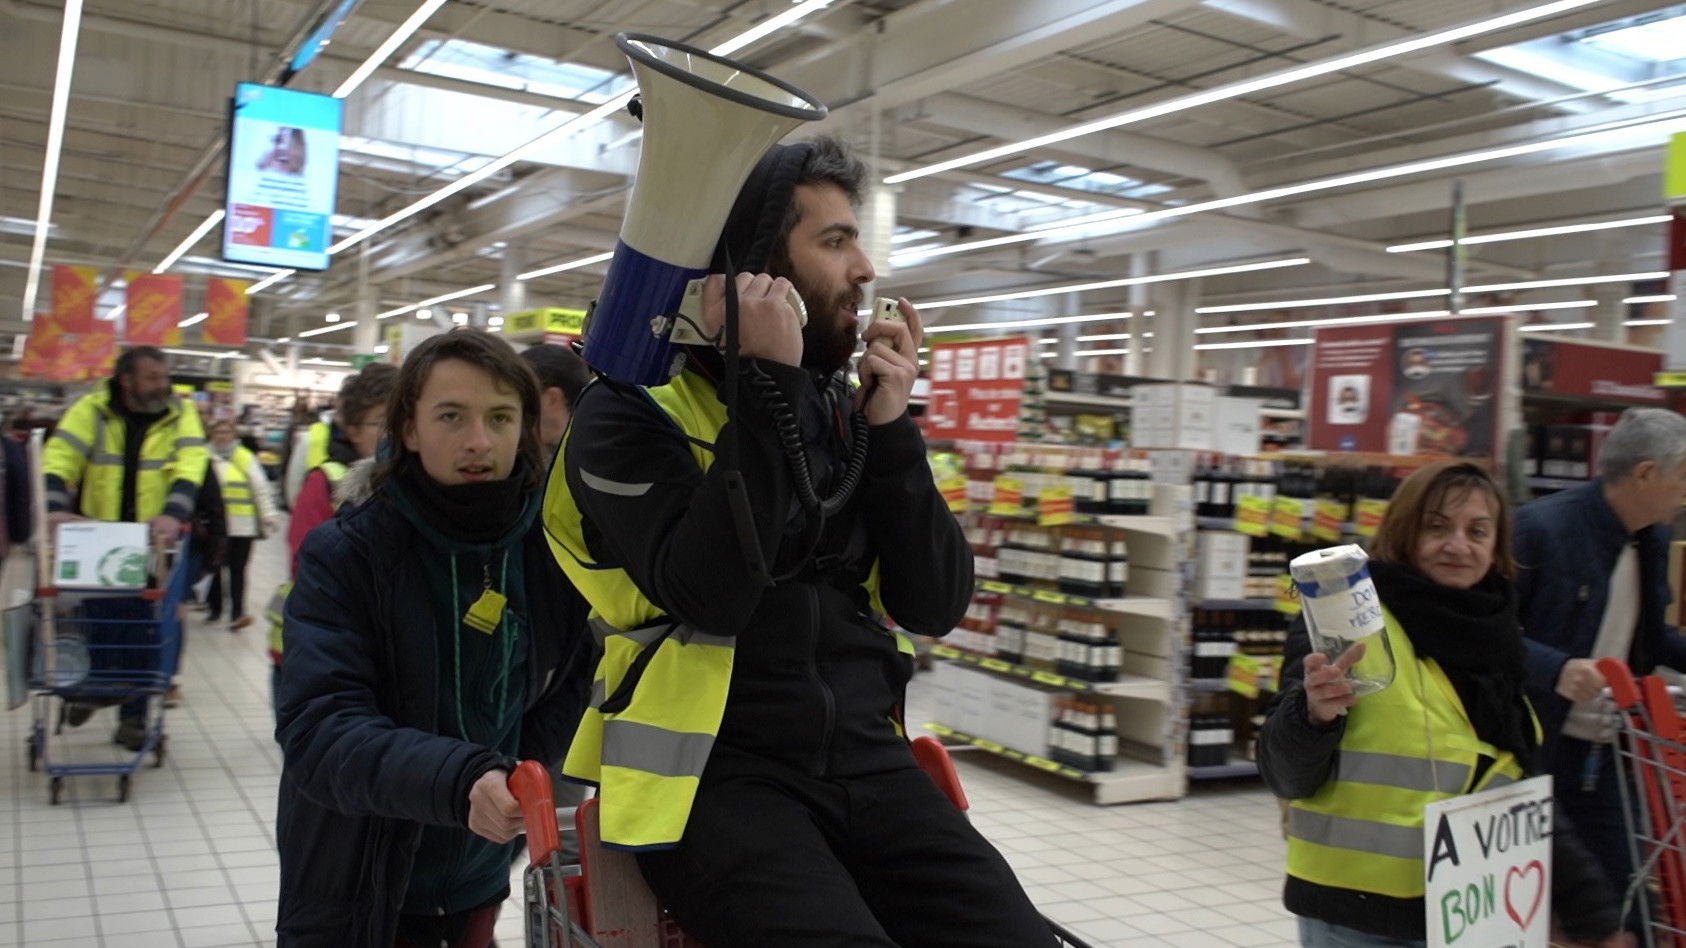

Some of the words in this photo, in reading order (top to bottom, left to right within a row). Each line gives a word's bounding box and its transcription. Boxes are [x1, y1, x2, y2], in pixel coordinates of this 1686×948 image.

[1427, 812, 1460, 882] A
[1473, 797, 1553, 859] VOTRE
[1441, 873, 1495, 944] BON
